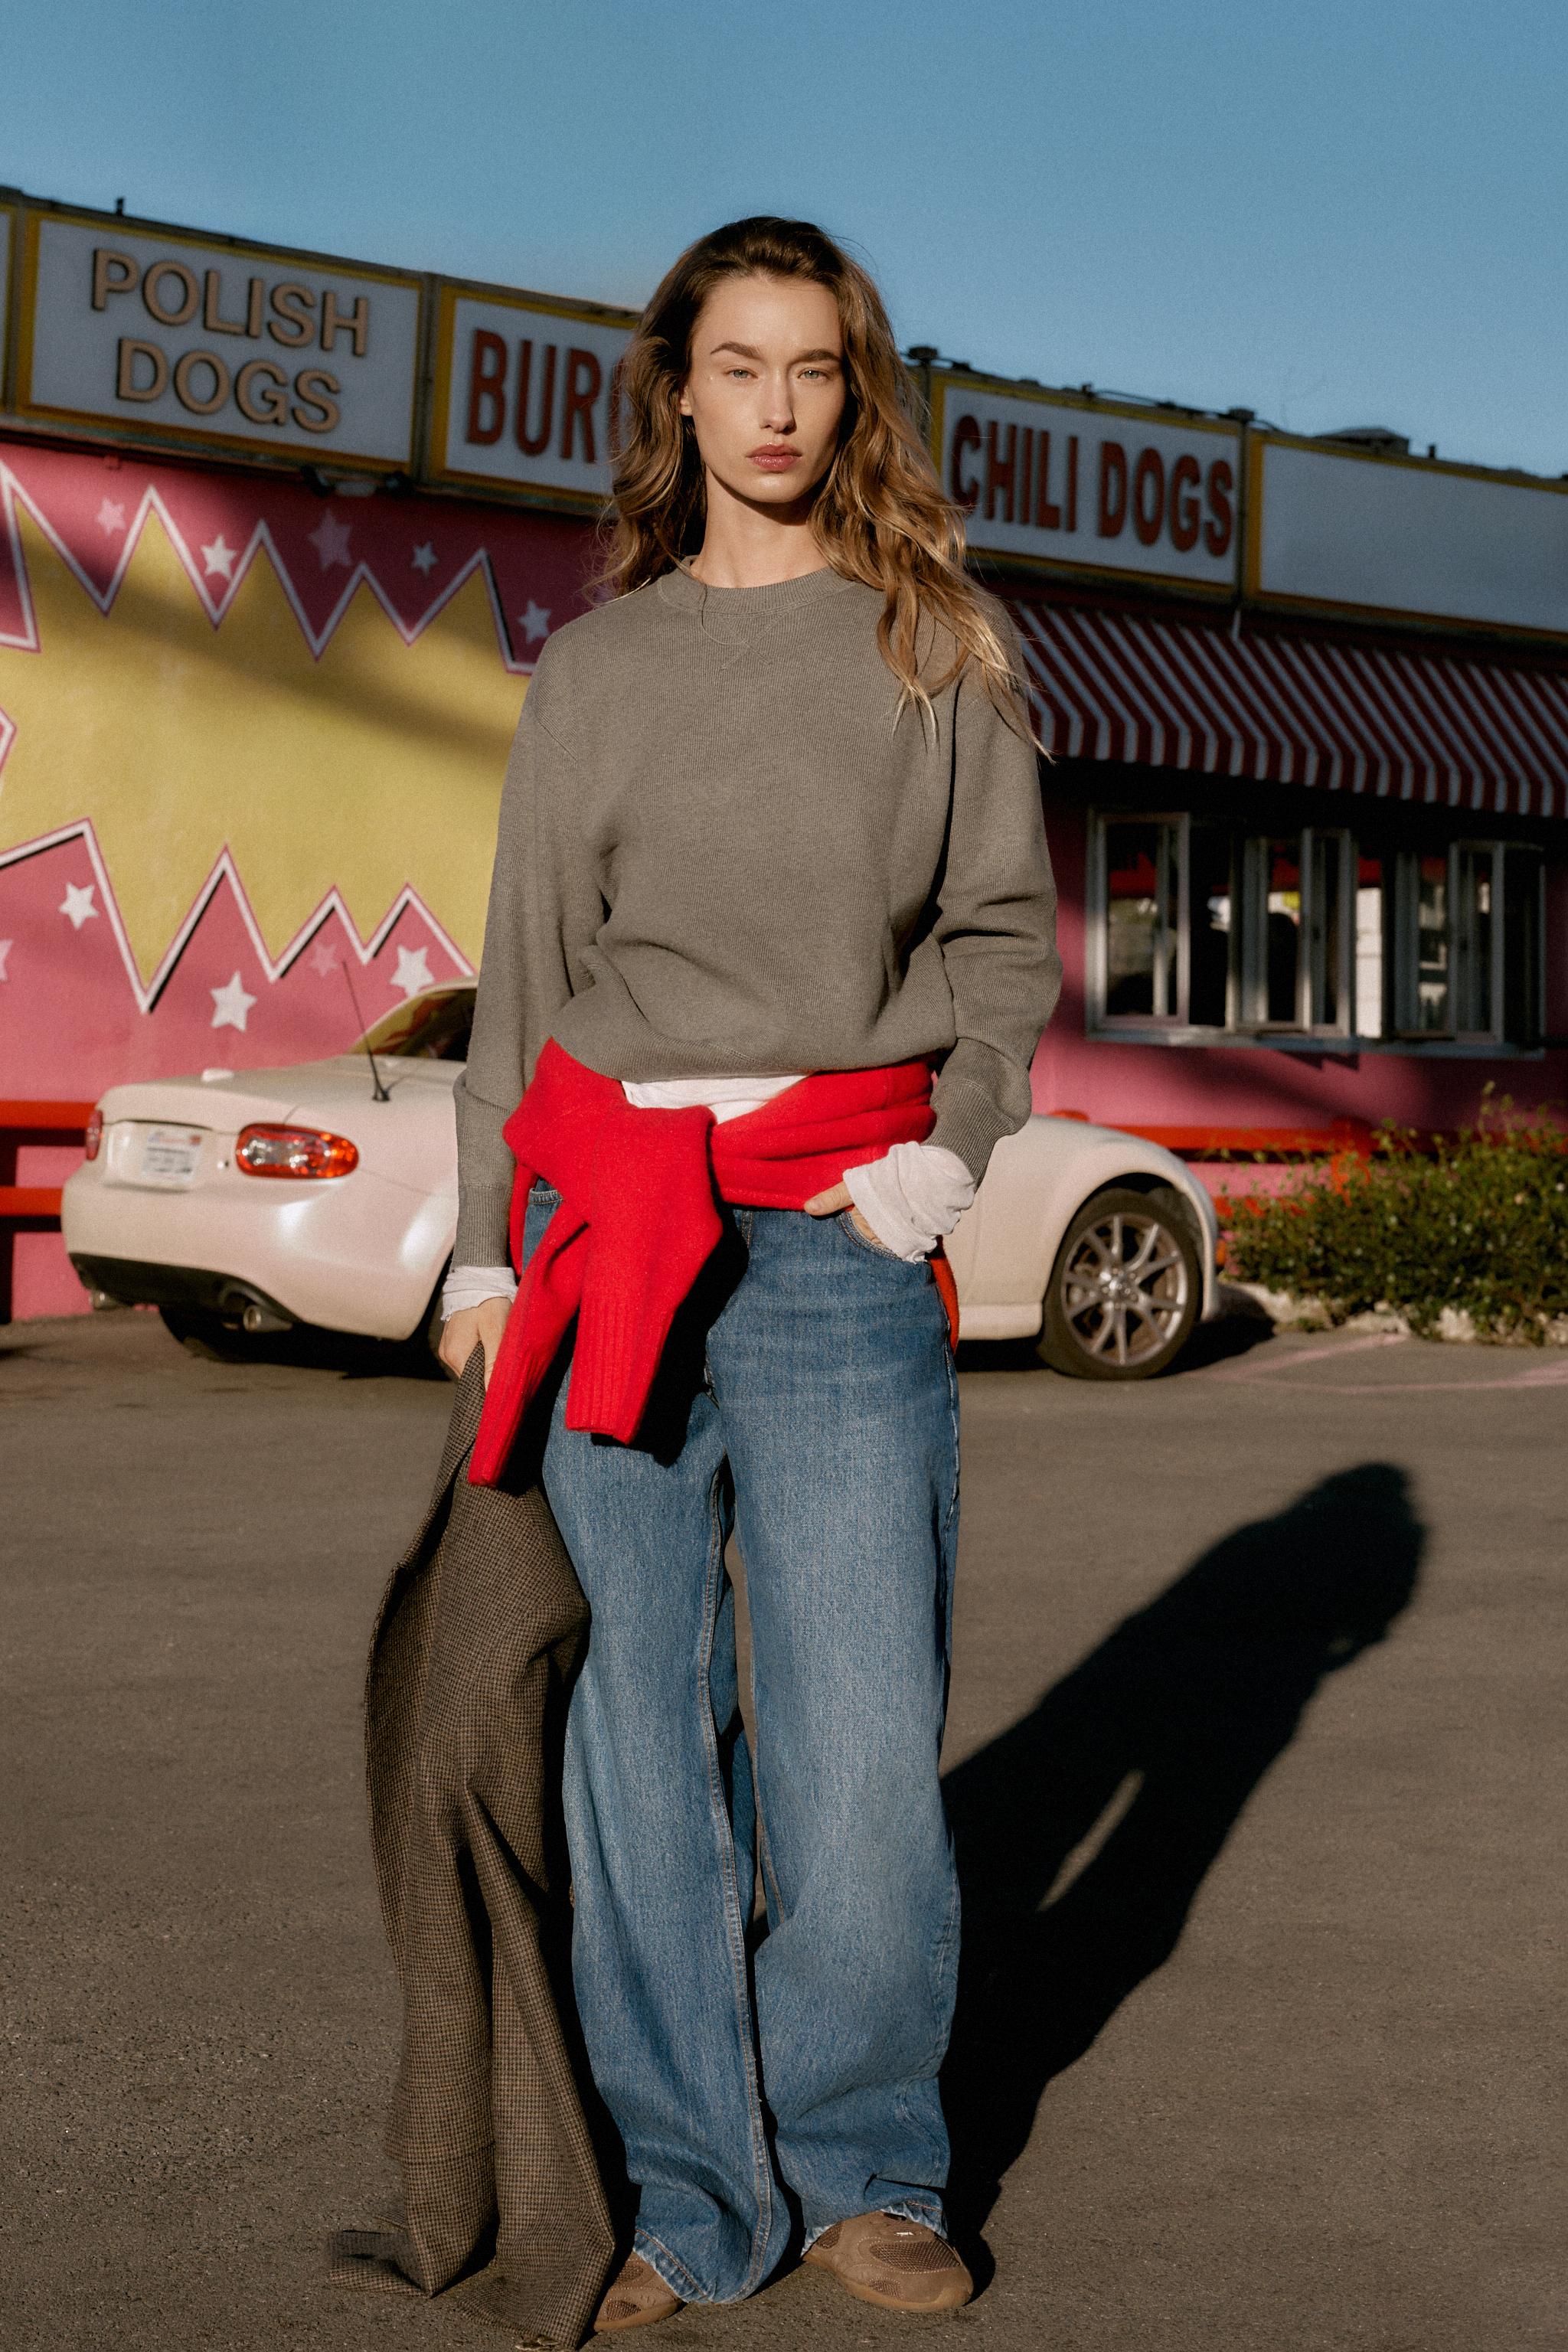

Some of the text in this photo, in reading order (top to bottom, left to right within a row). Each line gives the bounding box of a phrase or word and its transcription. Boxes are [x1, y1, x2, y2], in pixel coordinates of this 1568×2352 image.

[92, 248, 369, 358] POLISH
[116, 337, 341, 433] DOGS
[950, 414, 1233, 558] CHILI DOGS
